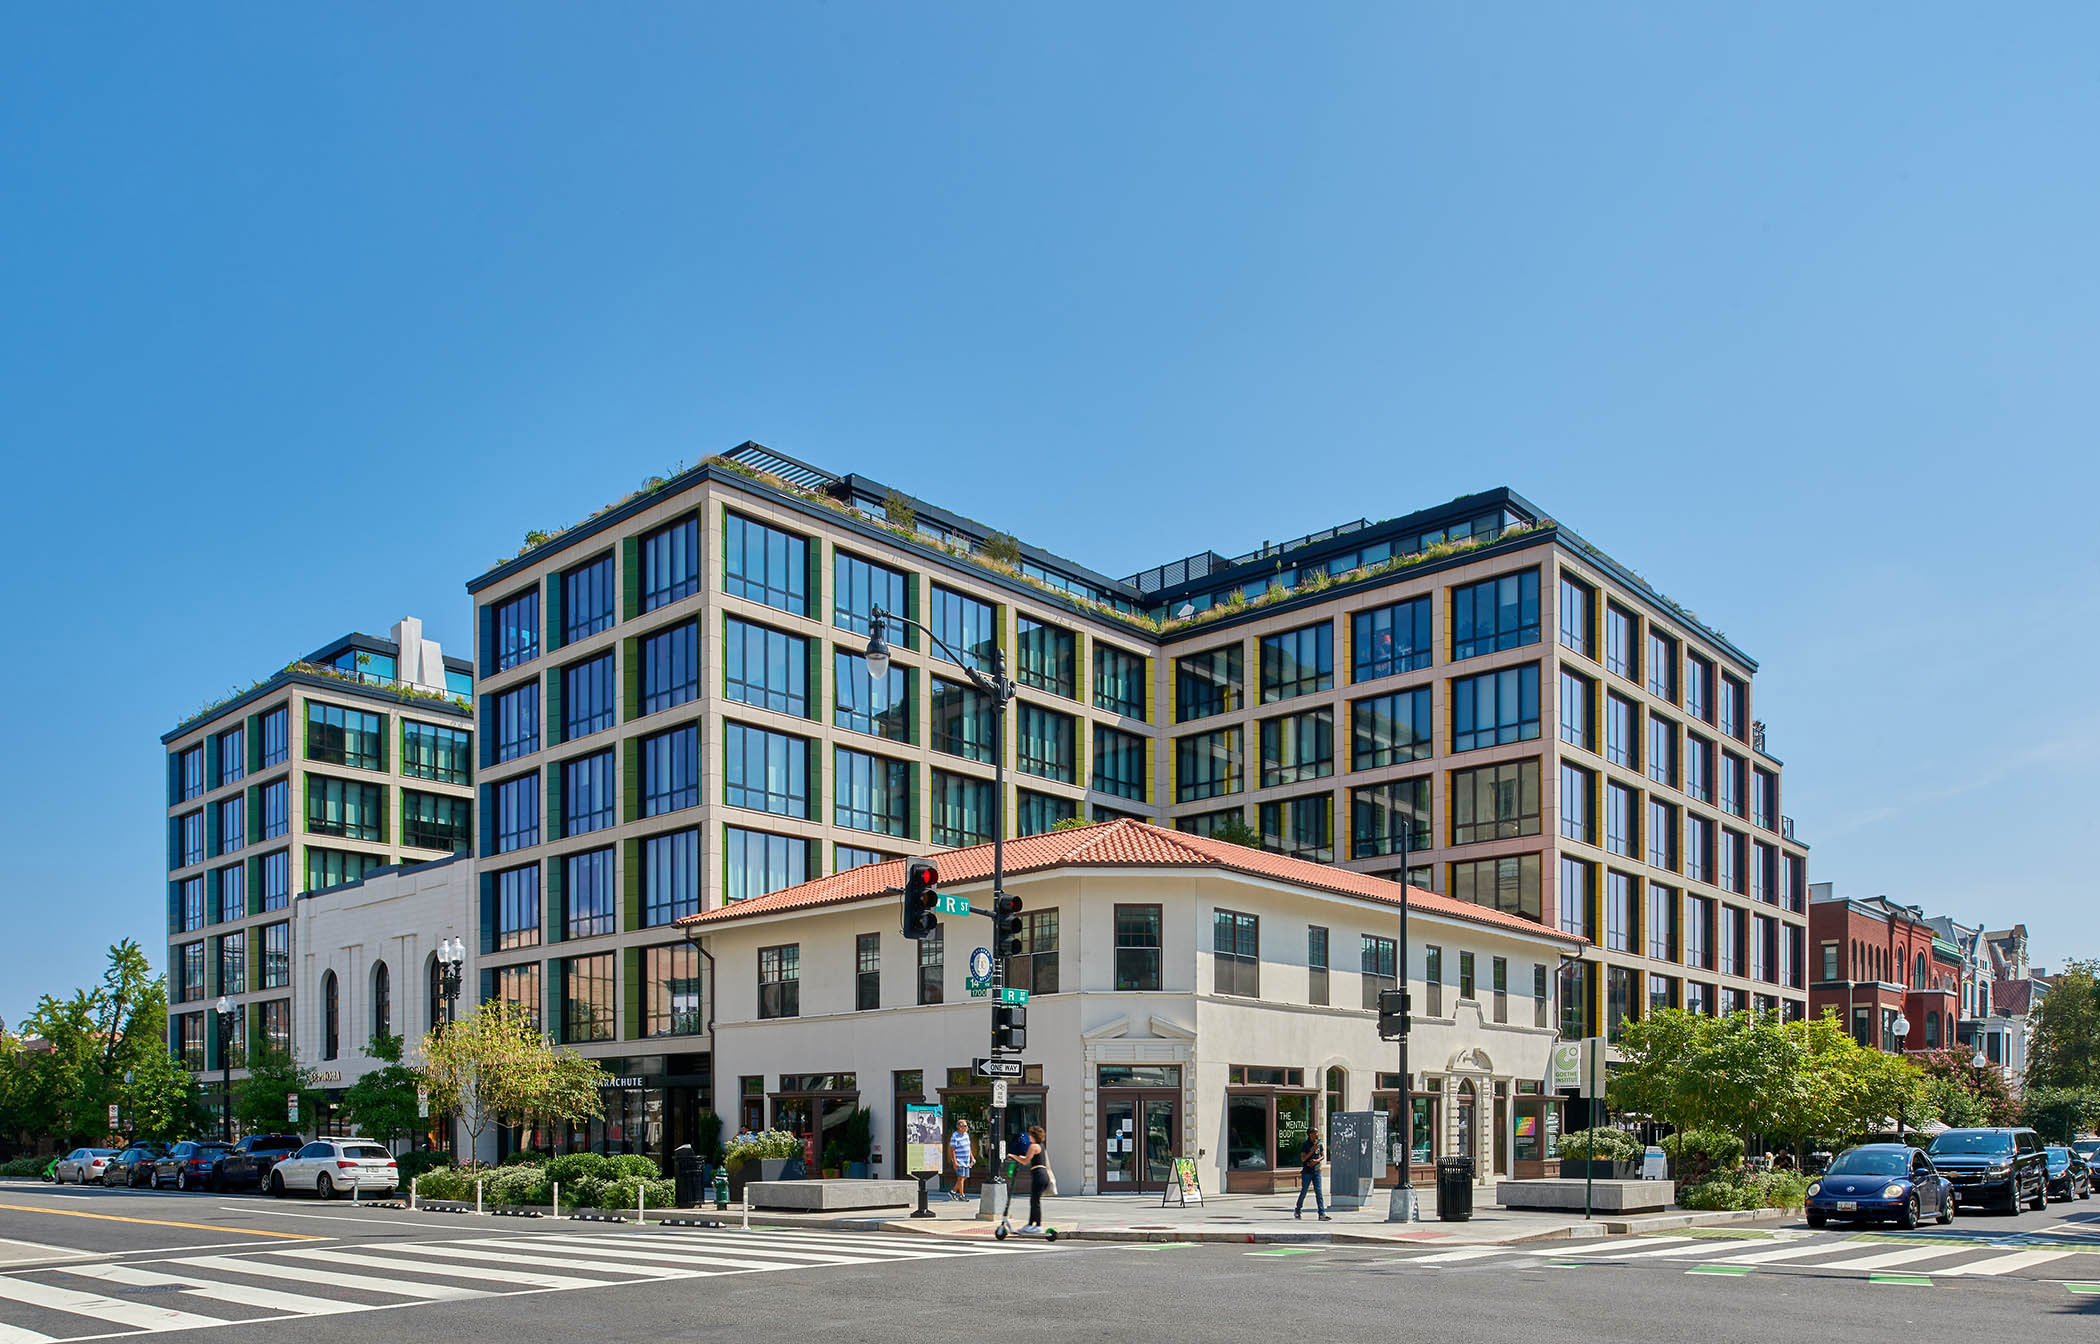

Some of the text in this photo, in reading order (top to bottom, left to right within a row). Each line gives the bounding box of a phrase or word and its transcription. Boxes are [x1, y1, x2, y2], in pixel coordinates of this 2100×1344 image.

[946, 896, 956, 913] R
[960, 902, 969, 911] ST
[970, 979, 979, 988] 14
[971, 990, 986, 998] 1700
[1008, 990, 1015, 1001] R
[990, 1063, 1018, 1072] ONE WAY
[1279, 1111, 1291, 1120] THE
[1285, 1121, 1308, 1130] MENTAL
[1279, 1130, 1294, 1138] BODY
